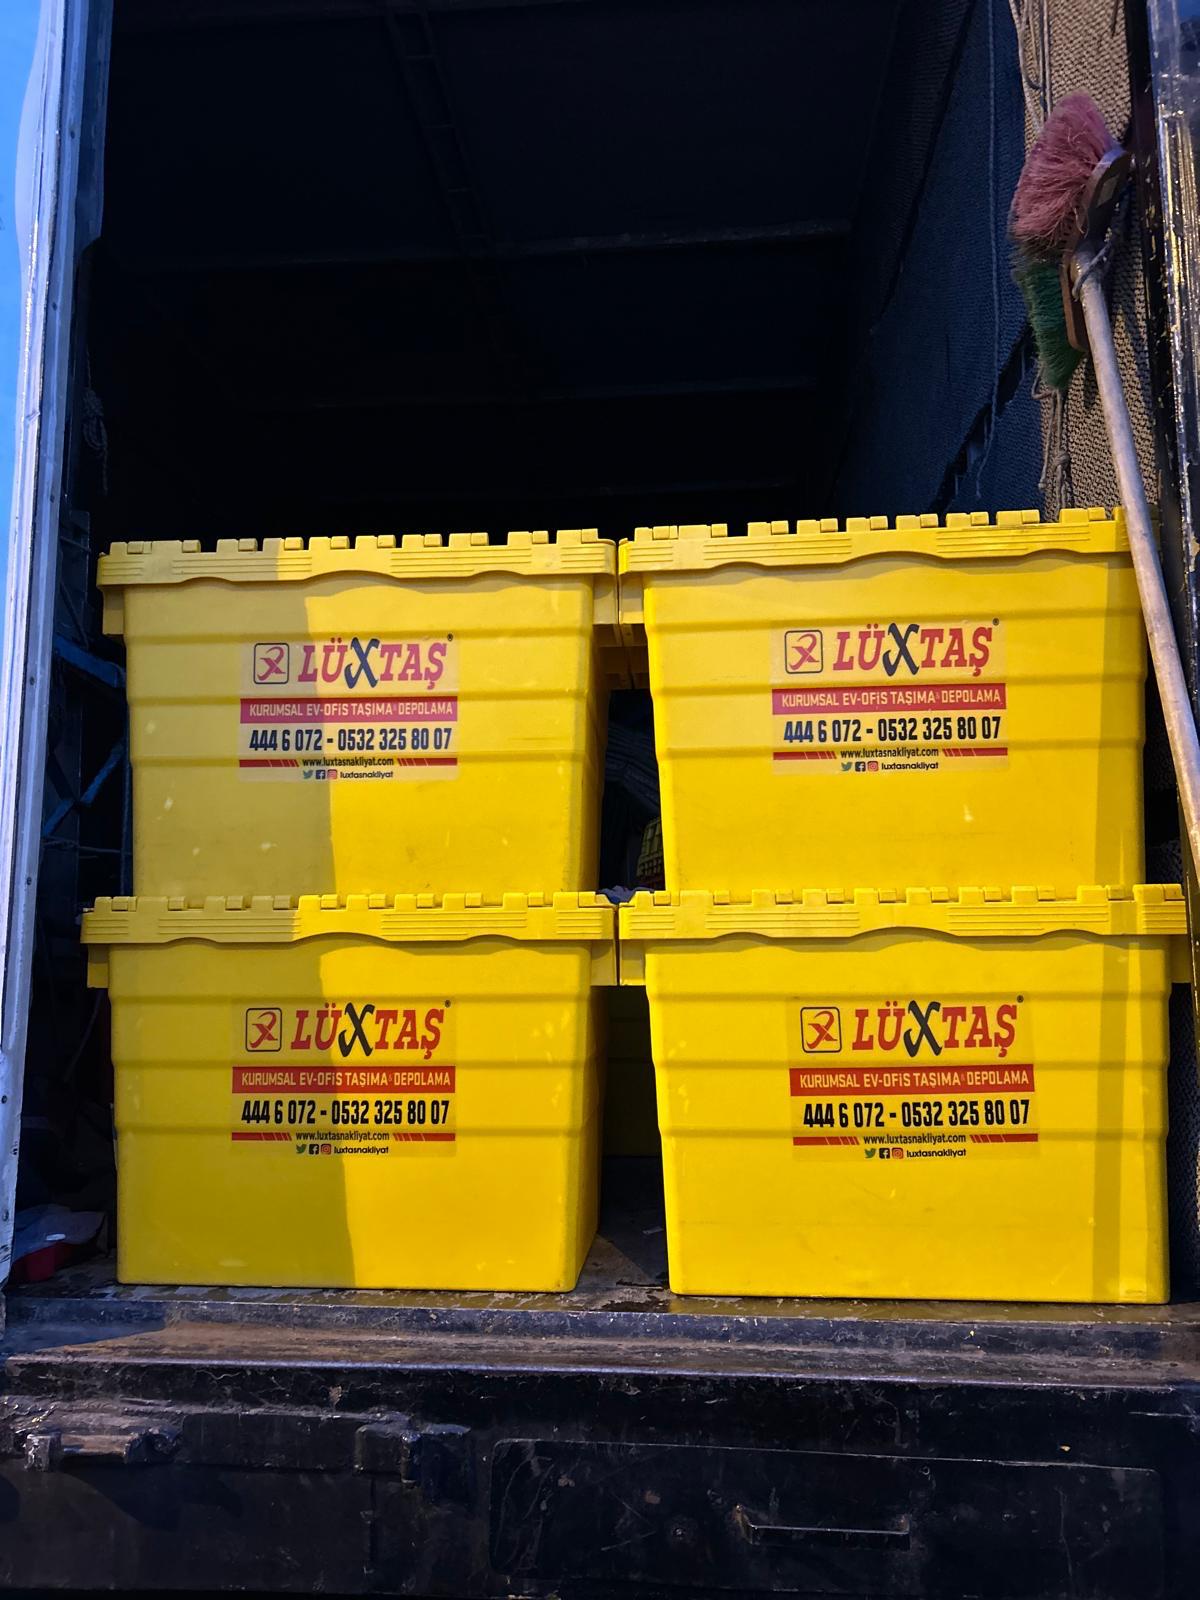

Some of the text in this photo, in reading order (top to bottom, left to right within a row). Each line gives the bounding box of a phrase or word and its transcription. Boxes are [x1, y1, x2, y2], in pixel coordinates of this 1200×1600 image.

[782, 695, 839, 707] KURUMSAL
[890, 691, 935, 705] TAŞIMA
[941, 689, 1000, 703] DEPOLAMA
[250, 704, 303, 716] KURUMSAL
[352, 703, 392, 716] TAŞIMA
[399, 702, 452, 714] DEPOLAMA
[784, 721, 813, 742] 444
[819, 720, 827, 742] 6
[833, 719, 861, 742] 072
[878, 718, 917, 740] 0532
[923, 717, 952, 740] 325
[958, 717, 976, 739] 80
[982, 716, 1001, 739] 07
[249, 730, 277, 751] 444
[282, 730, 290, 751] 6
[296, 729, 322, 751] 072
[338, 729, 374, 750] 0532
[379, 729, 406, 750] 325
[412, 728, 429, 750] 80
[434, 728, 452, 749] 07
[841, 747, 939, 759] www.luxtasnakliyat.com
[303, 758, 394, 767] www.luxtasnakliyat.com
[881, 762, 938, 770] luxtasnakliyat
[340, 771, 393, 779] luxtasnakliyat
[242, 1072, 296, 1086] KURUMSAL
[345, 1072, 388, 1088] TAŞIMA
[394, 1072, 450, 1086] DEPOLAMA
[800, 1074, 860, 1088] KURUMSAL
[913, 1071, 960, 1089] TAŞIMA
[968, 1070, 1028, 1085] DEPOLAMA
[241, 1100, 270, 1124] 444
[274, 1100, 282, 1124] 6
[288, 1100, 315, 1124] 072
[332, 1100, 369, 1124] 0532
[374, 1100, 402, 1124] 325
[408, 1100, 425, 1124] 80
[431, 1100, 449, 1124] 07
[803, 1104, 834, 1127] 444
[839, 1103, 848, 1127] 6
[854, 1102, 884, 1127] 072
[902, 1102, 943, 1126] 0532
[949, 1101, 979, 1125] 325
[985, 1100, 1004, 1125] 80
[1010, 1099, 1029, 1124] 07
[296, 1131, 389, 1142] www.luxtasnakliyat.com
[864, 1134, 966, 1145] www.luxtasnakliyat.com
[334, 1146, 388, 1155] luxtasnakliyat
[907, 1149, 966, 1158] luxtasnakliyat
